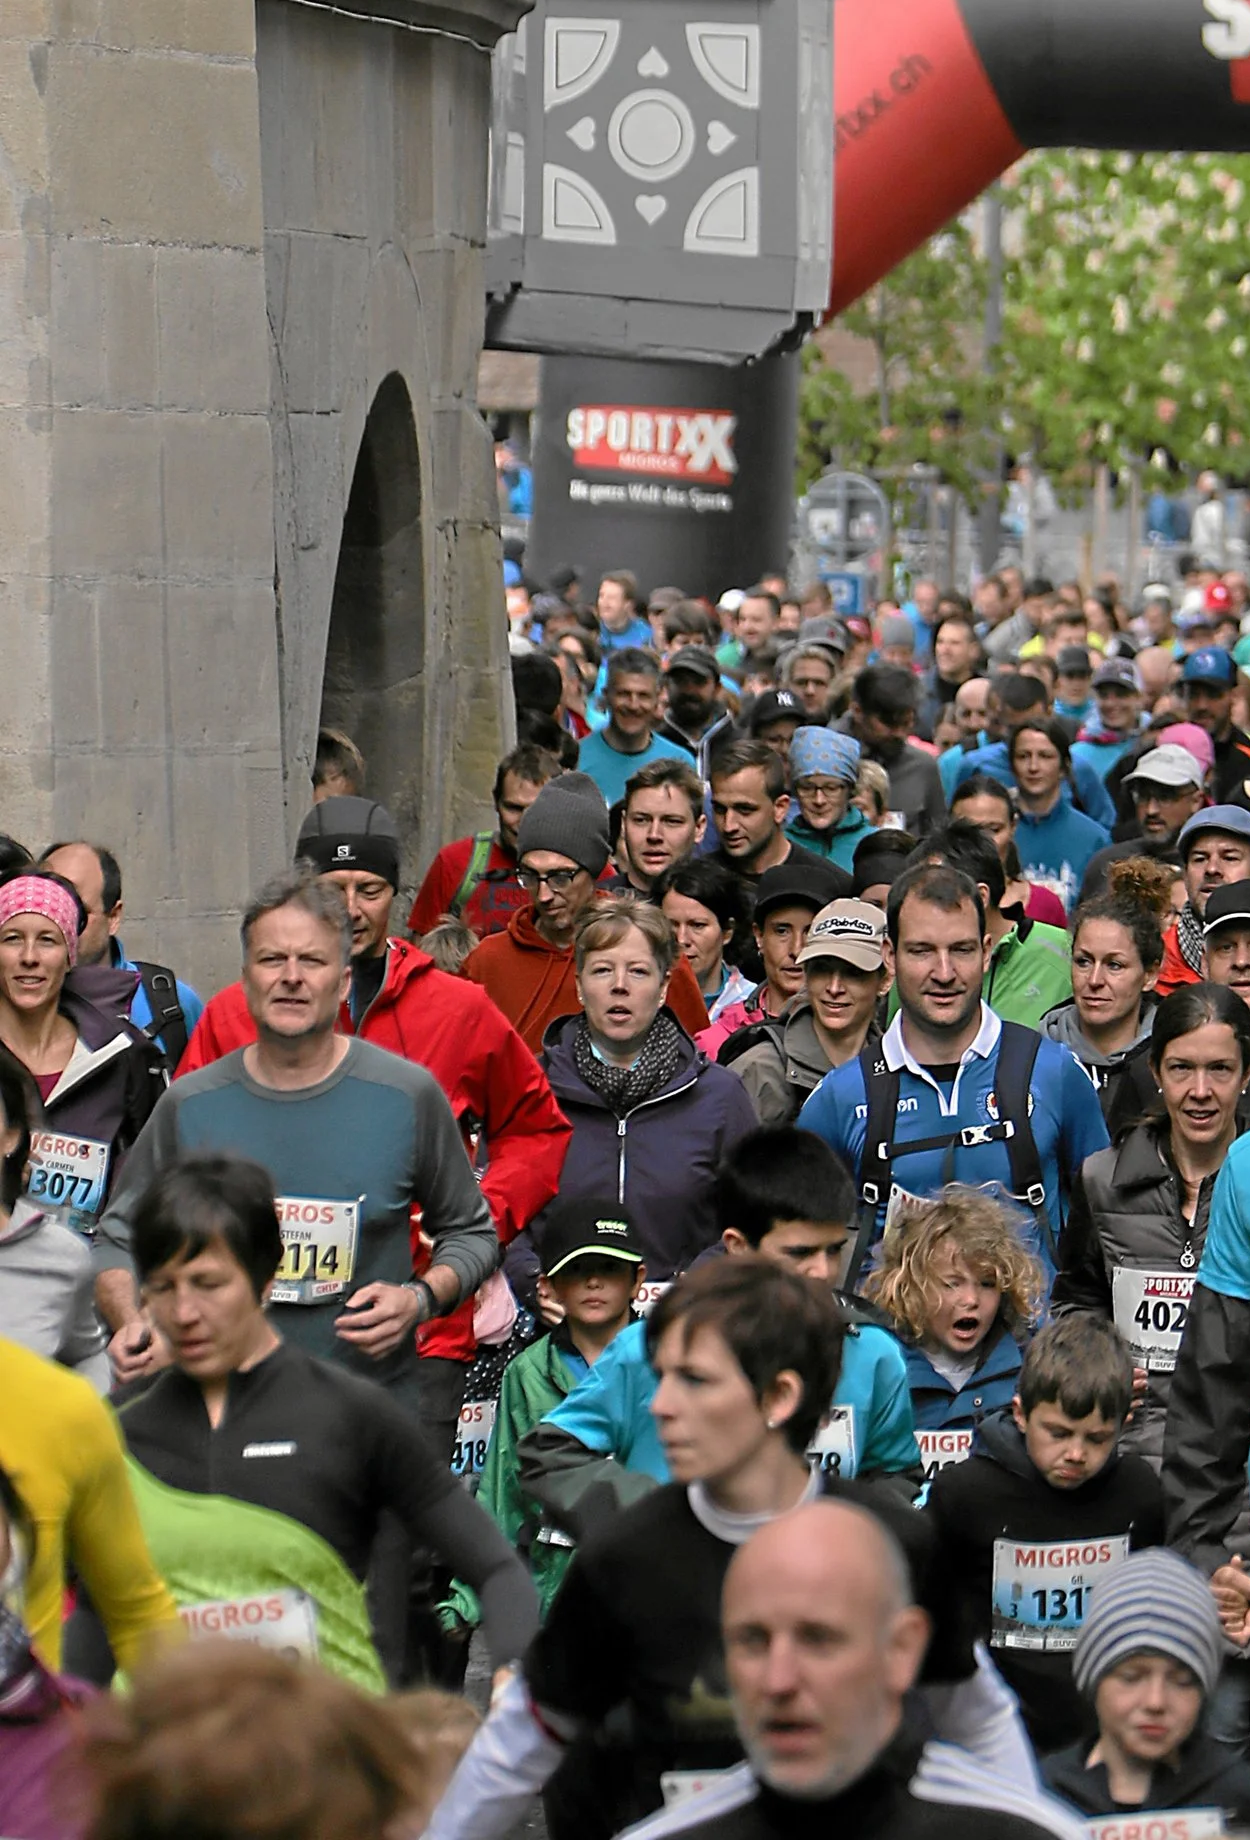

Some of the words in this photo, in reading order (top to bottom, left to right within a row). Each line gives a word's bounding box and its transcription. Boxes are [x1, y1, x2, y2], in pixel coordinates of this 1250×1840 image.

[567, 408, 738, 474] SPORTXX
[628, 482, 662, 504] Welt
[45, 1160, 75, 1173] CARMEN
[280, 1229, 312, 1241] STEFAN
[1014, 1544, 1111, 1568] MIGROS
[1010, 1603, 1018, 1618] 3
[1032, 1586, 1093, 1621] 131
